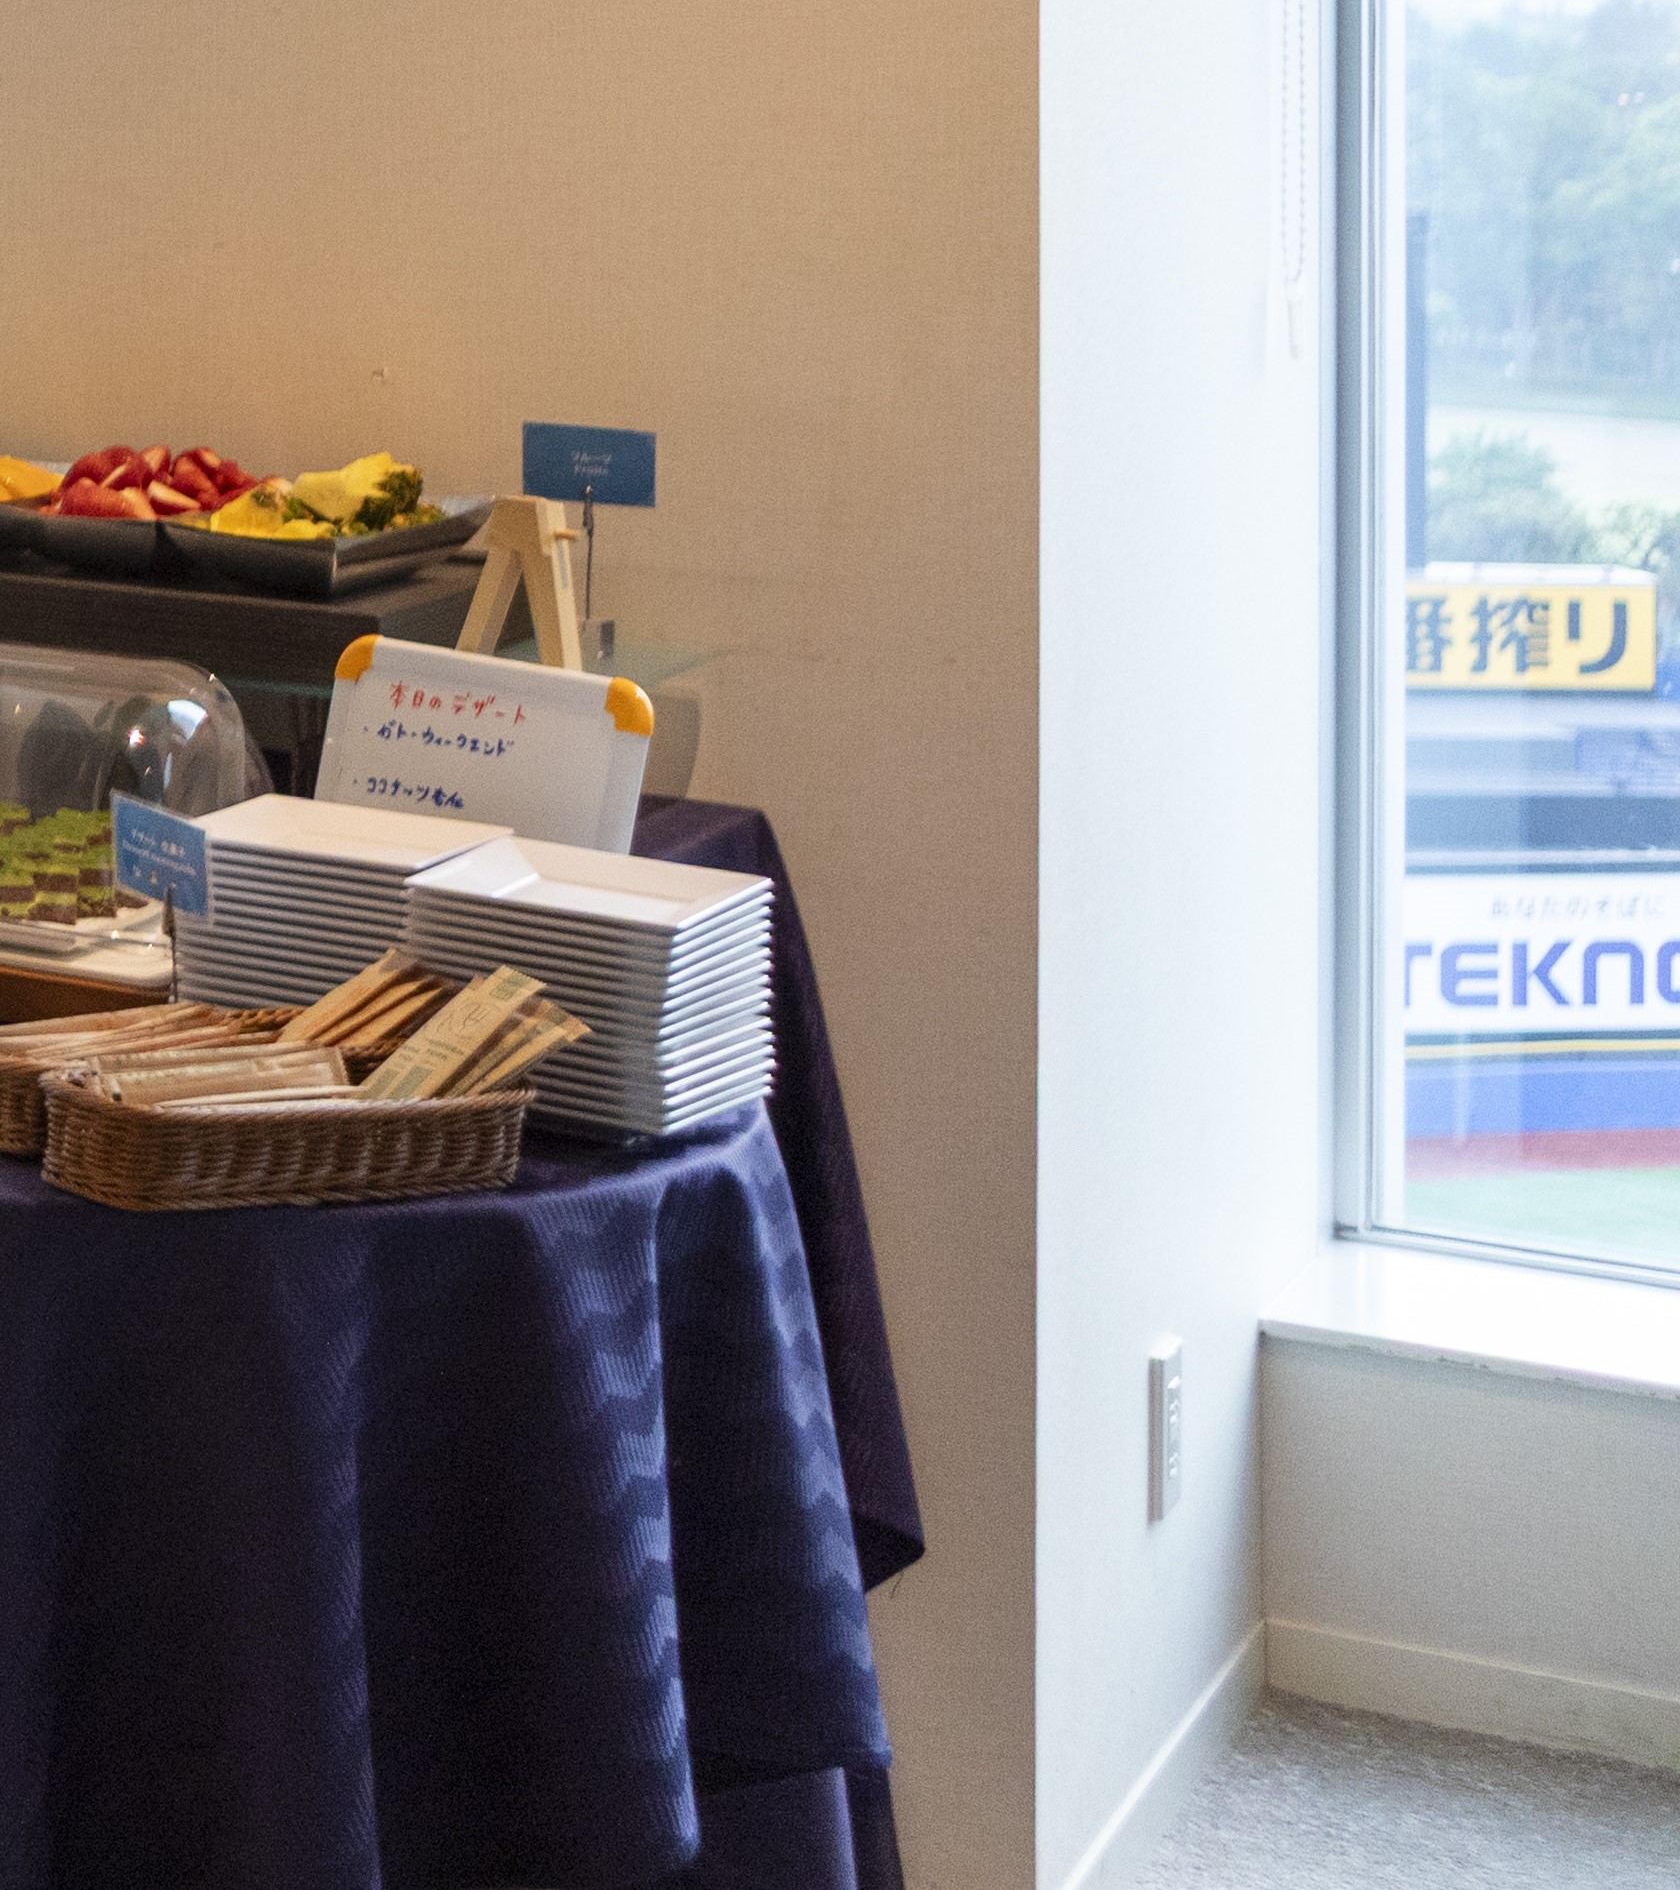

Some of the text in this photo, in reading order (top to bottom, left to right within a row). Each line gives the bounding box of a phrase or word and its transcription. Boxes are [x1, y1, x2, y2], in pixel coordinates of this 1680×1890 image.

[389, 681, 527, 726] 本日のデザート
